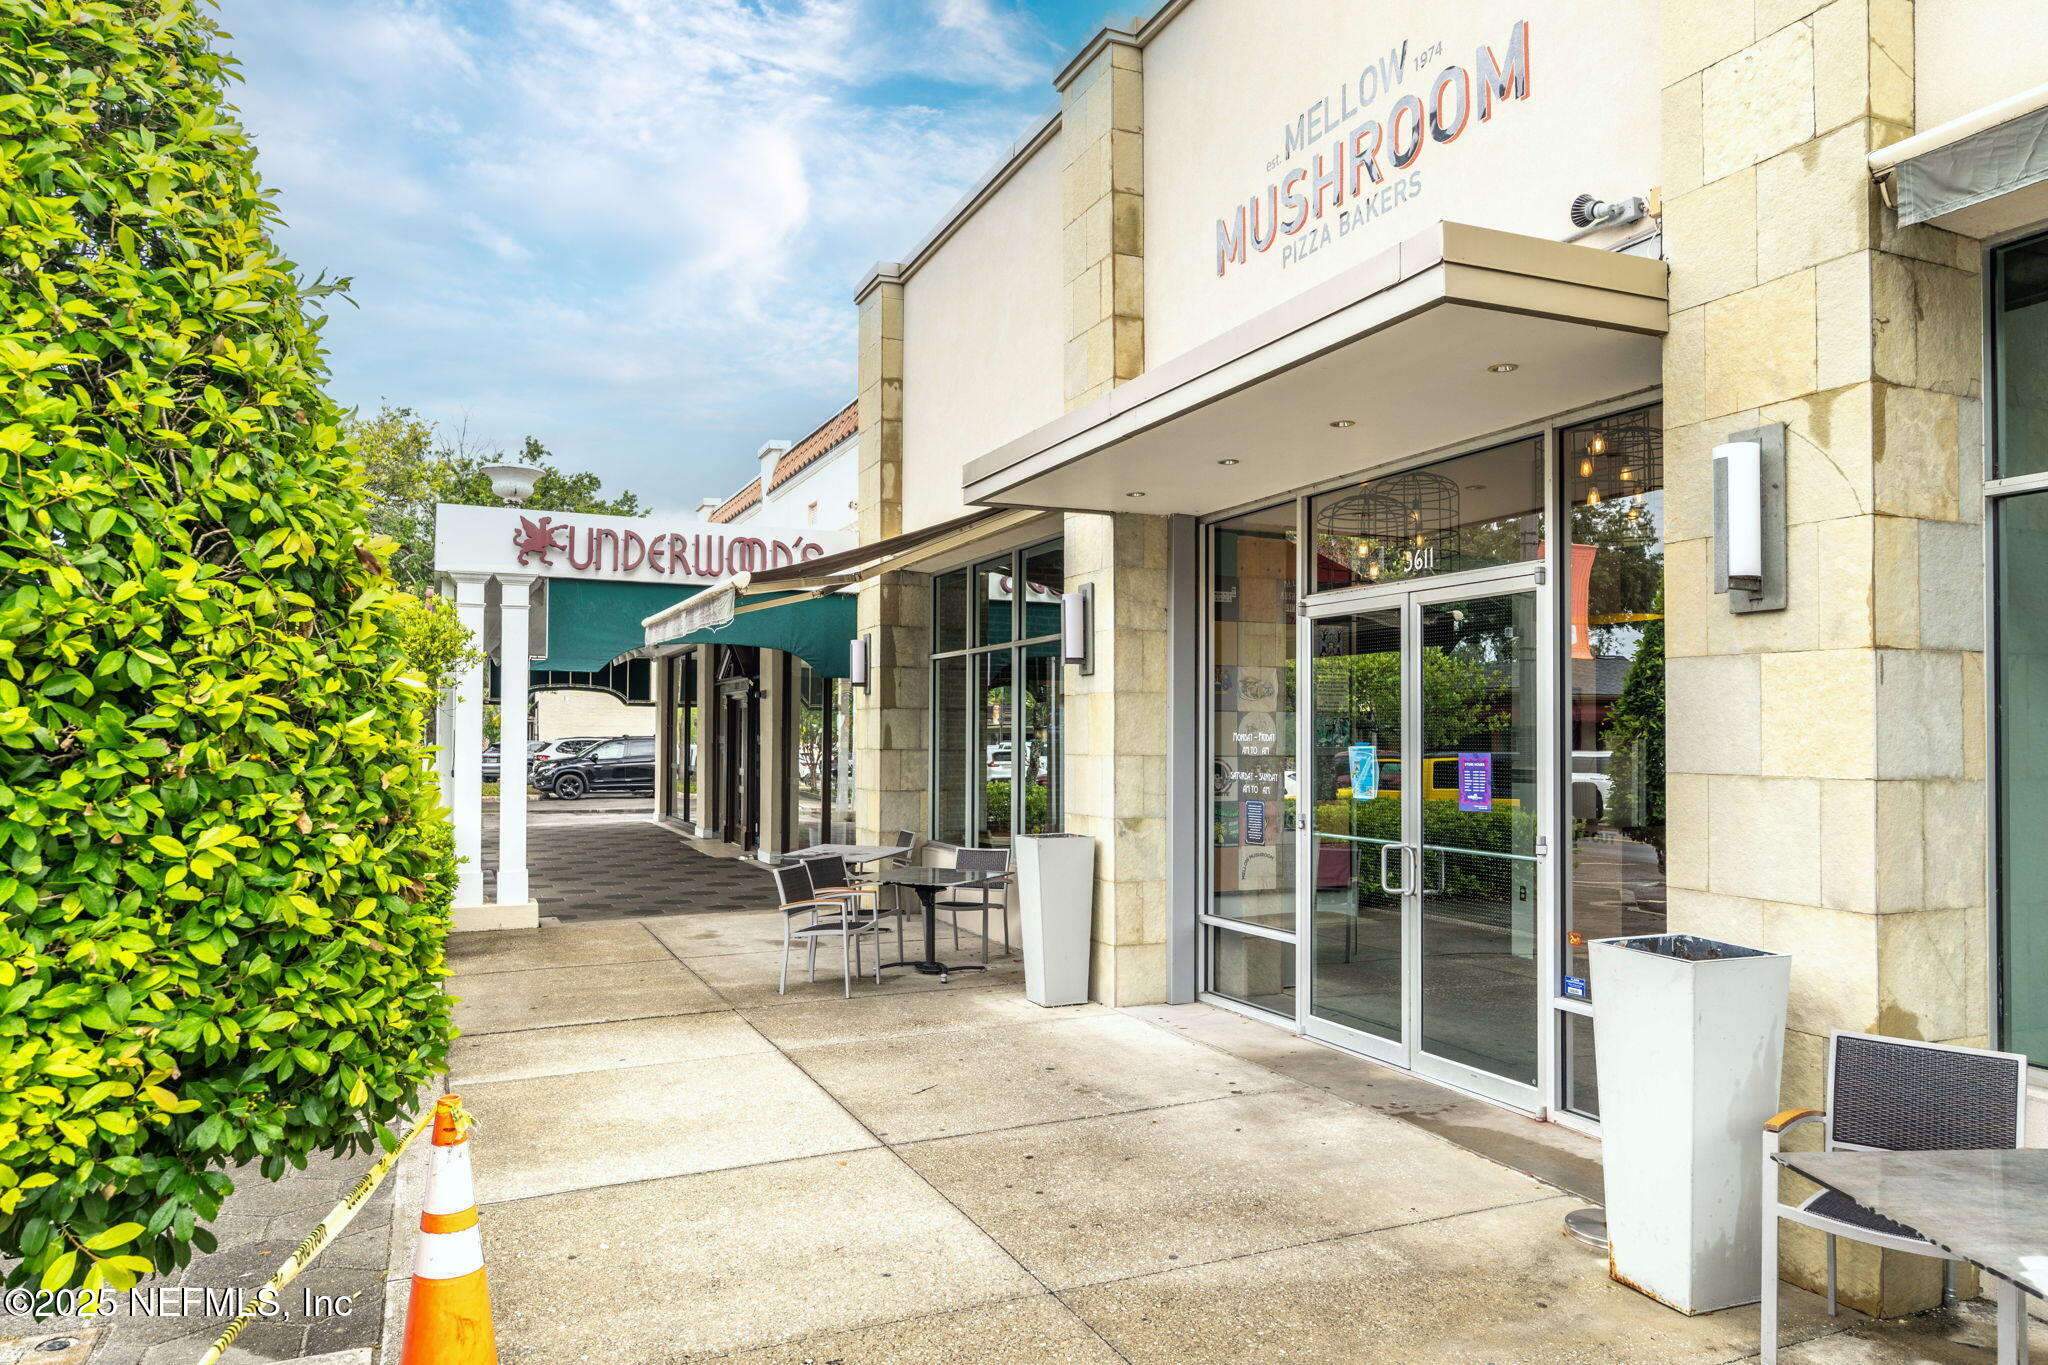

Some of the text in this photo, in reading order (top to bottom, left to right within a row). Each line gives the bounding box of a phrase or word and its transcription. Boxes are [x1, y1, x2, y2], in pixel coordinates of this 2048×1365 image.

[1216, 19, 1531, 278] MUSHROOM
[1266, 39, 1443, 172] est. MELLOW 1974
[1282, 170, 1422, 269] PIZZA BAKERS
